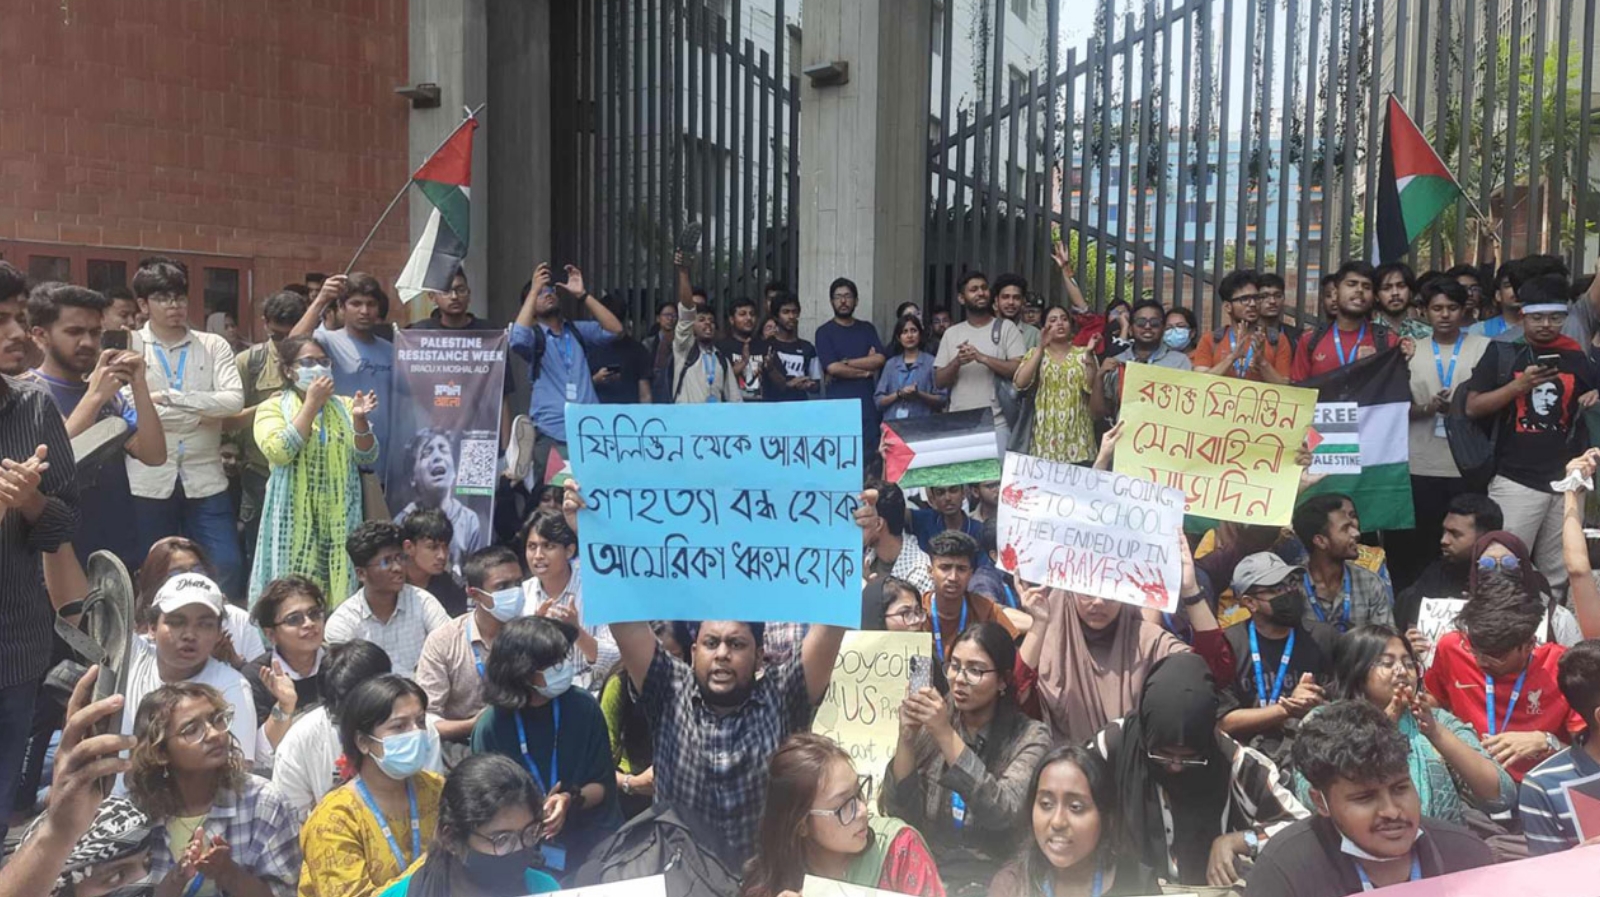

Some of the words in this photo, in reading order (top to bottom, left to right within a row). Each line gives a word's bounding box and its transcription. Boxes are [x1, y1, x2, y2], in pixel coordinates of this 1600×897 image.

[398, 349, 469, 361] RESISTANCE
[471, 350, 504, 361] WEEK
[420, 337, 482, 348] PALESTINE
[1139, 380, 1197, 415] রক্তাক্ত
[1202, 381, 1305, 429] ফিলিস্তিন
[577, 413, 683, 463] ফিলিস্তিন
[690, 435, 752, 460] থেকে
[760, 435, 862, 470] আরাকান
[1133, 422, 1286, 473] সেনাবাহিনী
[1312, 455, 1361, 466] ALESTINE
[1012, 454, 1081, 487] INSTEAD
[1085, 471, 1109, 491] OF
[1113, 474, 1174, 507] GOING
[1215, 469, 1274, 517] দিন
[587, 488, 719, 525] গণহত্যা
[730, 488, 777, 521] বন্ধ
[1042, 490, 1075, 517] TO
[1088, 499, 1172, 536] SCHOOL
[588, 533, 726, 580] আমেরিকা
[795, 547, 854, 588] হোক
[1011, 515, 1060, 542] THEY
[1064, 527, 1114, 554] ENDED
[1117, 539, 1140, 559] UP
[1143, 543, 1169, 565] IN
[842, 685, 877, 725] US
